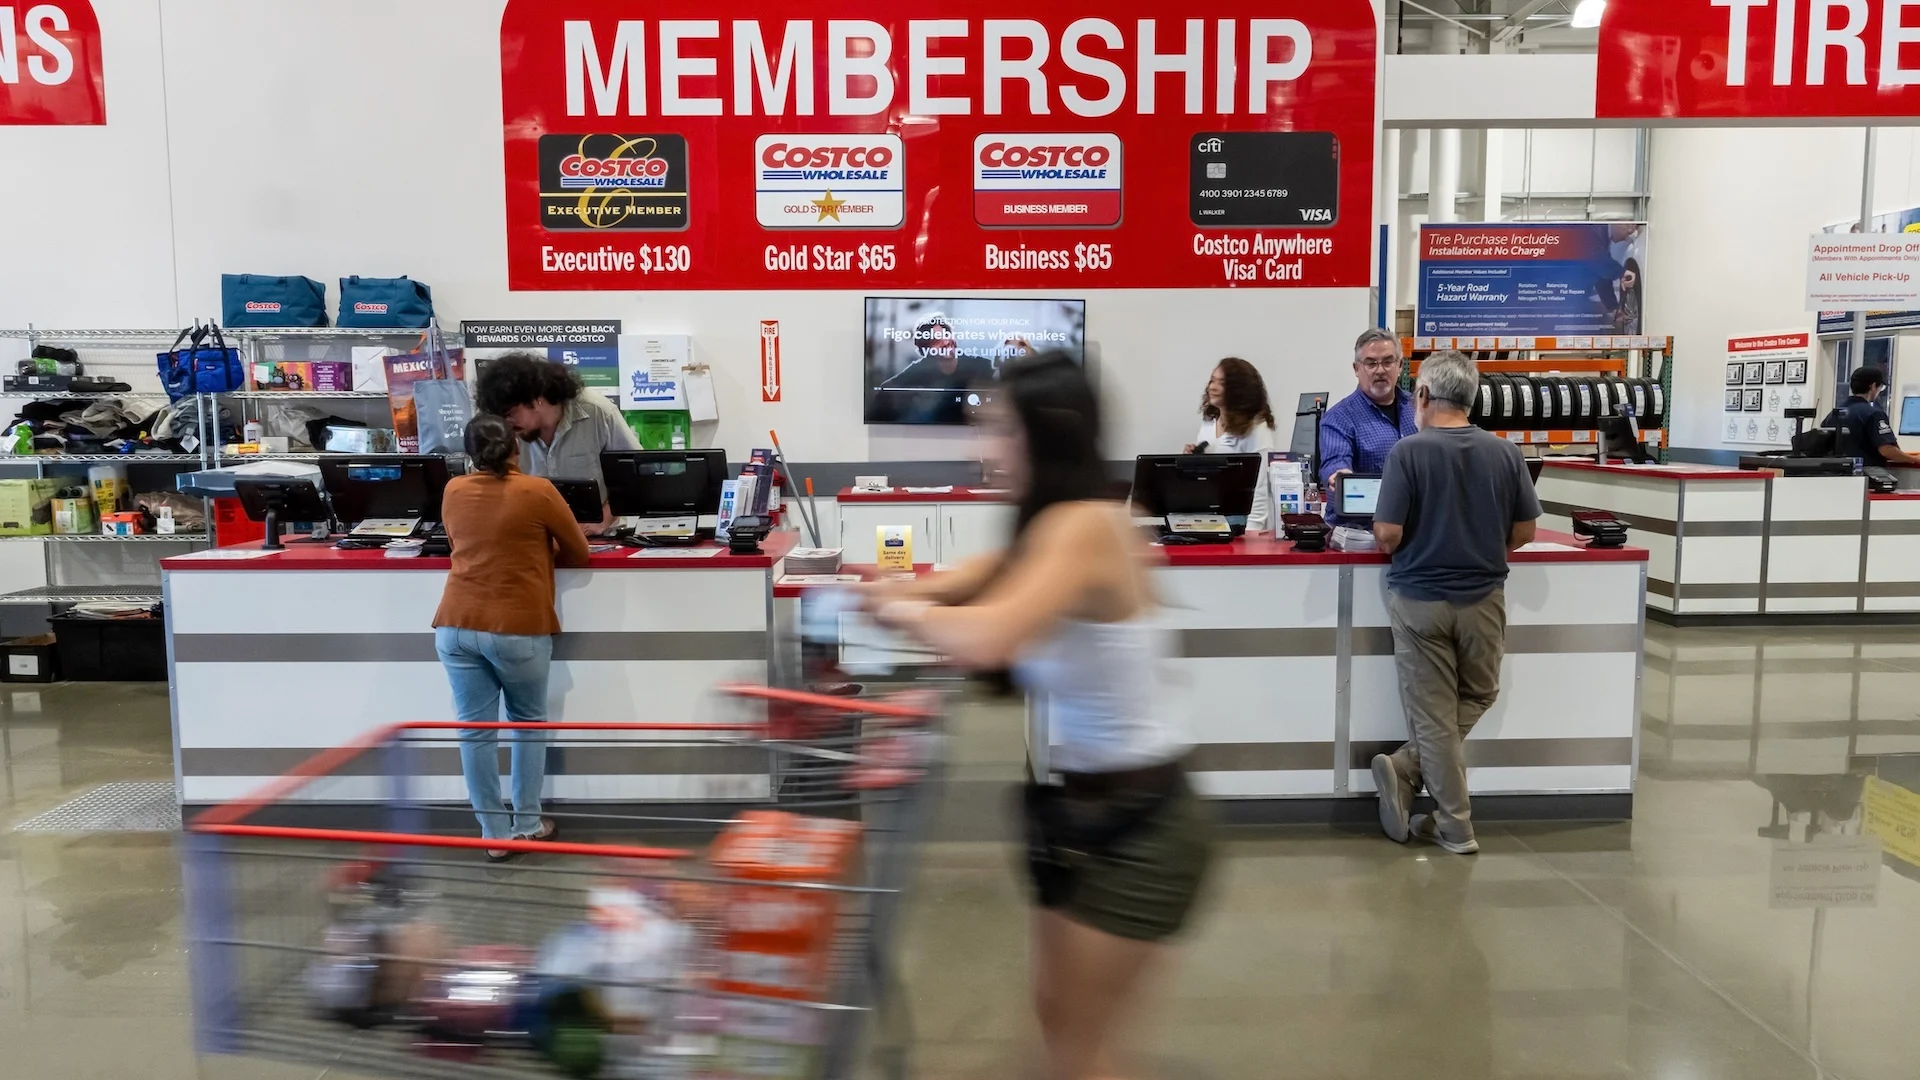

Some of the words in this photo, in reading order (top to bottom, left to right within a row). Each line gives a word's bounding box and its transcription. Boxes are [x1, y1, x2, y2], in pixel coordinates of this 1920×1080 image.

[1710, 0, 1920, 87] TIRE
[564, 17, 1313, 118] MEMBERSHIP
[762, 142, 893, 169] COSTCO
[979, 142, 1110, 168] COSTCO
[559, 154, 668, 178] COSTCO
[802, 169, 888, 181] WHOLESALE
[1020, 169, 1107, 180] WHOLESALE
[594, 177, 665, 187] WHOLESALE
[1199, 189, 1221, 198] 4100
[1222, 189, 1242, 198] 3901
[1244, 189, 1266, 198] 2345
[1266, 189, 1289, 198] 6789
[547, 204, 621, 216] EXECUTIVE
[624, 204, 682, 216] MEMBER
[784, 204, 809, 214] GOLD
[810, 204, 835, 214] STAR
[836, 204, 874, 214] MEMBER
[1003, 203, 1048, 215] BUSINESS
[1049, 203, 1088, 214] MEMBER
[1299, 208, 1332, 221] VISA
[1429, 233, 1452, 245] Tire
[1453, 234, 1508, 245] Purchase
[1511, 233, 1560, 245] Includes
[1193, 233, 1250, 256] Costco
[1253, 233, 1333, 259] Anywhere
[1429, 246, 1482, 256] Installation
[1482, 247, 1493, 255] at
[1494, 246, 1509, 256] No
[1814, 244, 1876, 255] Appointment
[1879, 244, 1902, 254] Drop
[1905, 243, 1920, 252] Off
[541, 245, 635, 272] Executive
[639, 243, 691, 274] $130
[765, 245, 809, 272] Gold
[812, 245, 854, 272] Star
[858, 243, 896, 274] $65
[985, 244, 1069, 270] Business
[1074, 242, 1112, 273] $65
[1265, 259, 1303, 280] Card
[1819, 273, 1832, 281] All
[1835, 273, 1870, 281] Vehicle
[1872, 272, 1910, 283] Pick-Up
[1438, 283, 1465, 292] 5-Year
[1466, 283, 1490, 292] Road
[1436, 293, 1467, 302] Hazard
[1468, 293, 1508, 303] Warranty
[355, 302, 387, 310] COSTCO
[970, 318, 986, 326] FOR
[987, 318, 1008, 326] YOUR
[1010, 318, 1031, 327] PACK
[466, 325, 488, 334] NOW
[489, 325, 512, 333] EARN
[513, 325, 537, 333] EVEN
[538, 325, 564, 333] MORE
[565, 325, 589, 333] CASH
[591, 325, 615, 333] BACK
[764, 327, 776, 335] FIRE
[883, 328, 912, 342] Figo
[913, 328, 985, 341] celebrates
[988, 328, 1024, 341] what
[1025, 329, 1066, 342] makes
[476, 335, 519, 343] REWARDS
[520, 334, 535, 343] ON
[536, 334, 554, 343] GAS
[556, 334, 567, 343] AT
[568, 334, 606, 343] COSTCO
[1734, 341, 1753, 349] Welcome
[1778, 338, 1786, 346] Tire
[922, 347, 953, 359] your
[955, 348, 978, 359] pet
[981, 347, 1027, 360] unique
